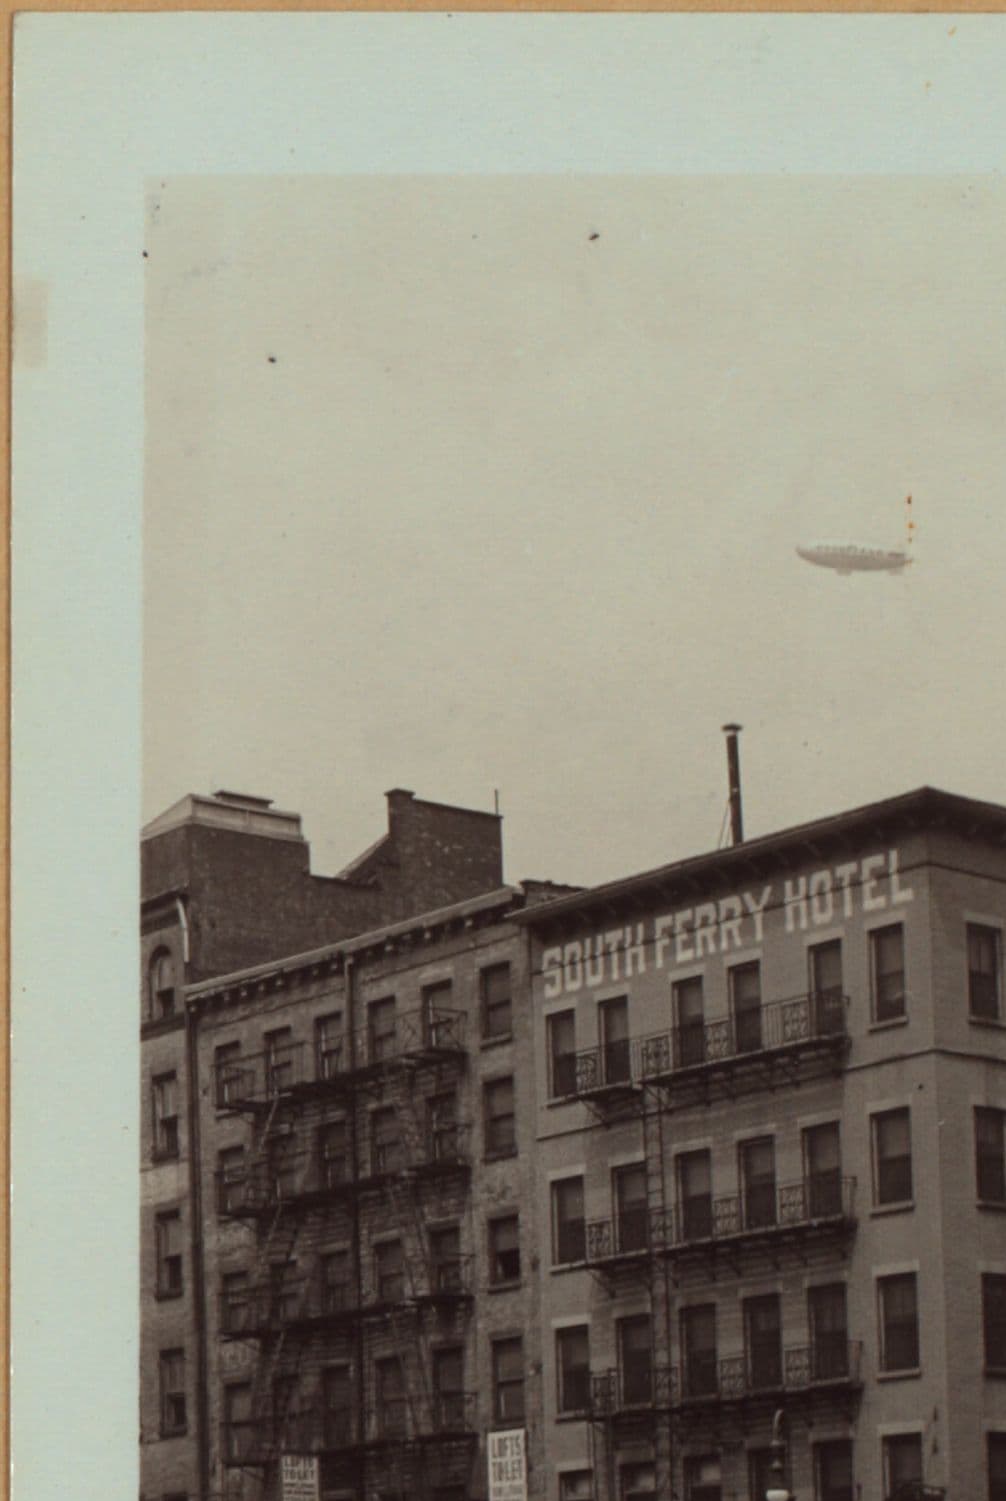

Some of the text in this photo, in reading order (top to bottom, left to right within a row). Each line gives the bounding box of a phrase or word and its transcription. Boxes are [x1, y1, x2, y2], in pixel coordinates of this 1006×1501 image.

[541, 849, 915, 998] SOUTH FERRY HOTEL
